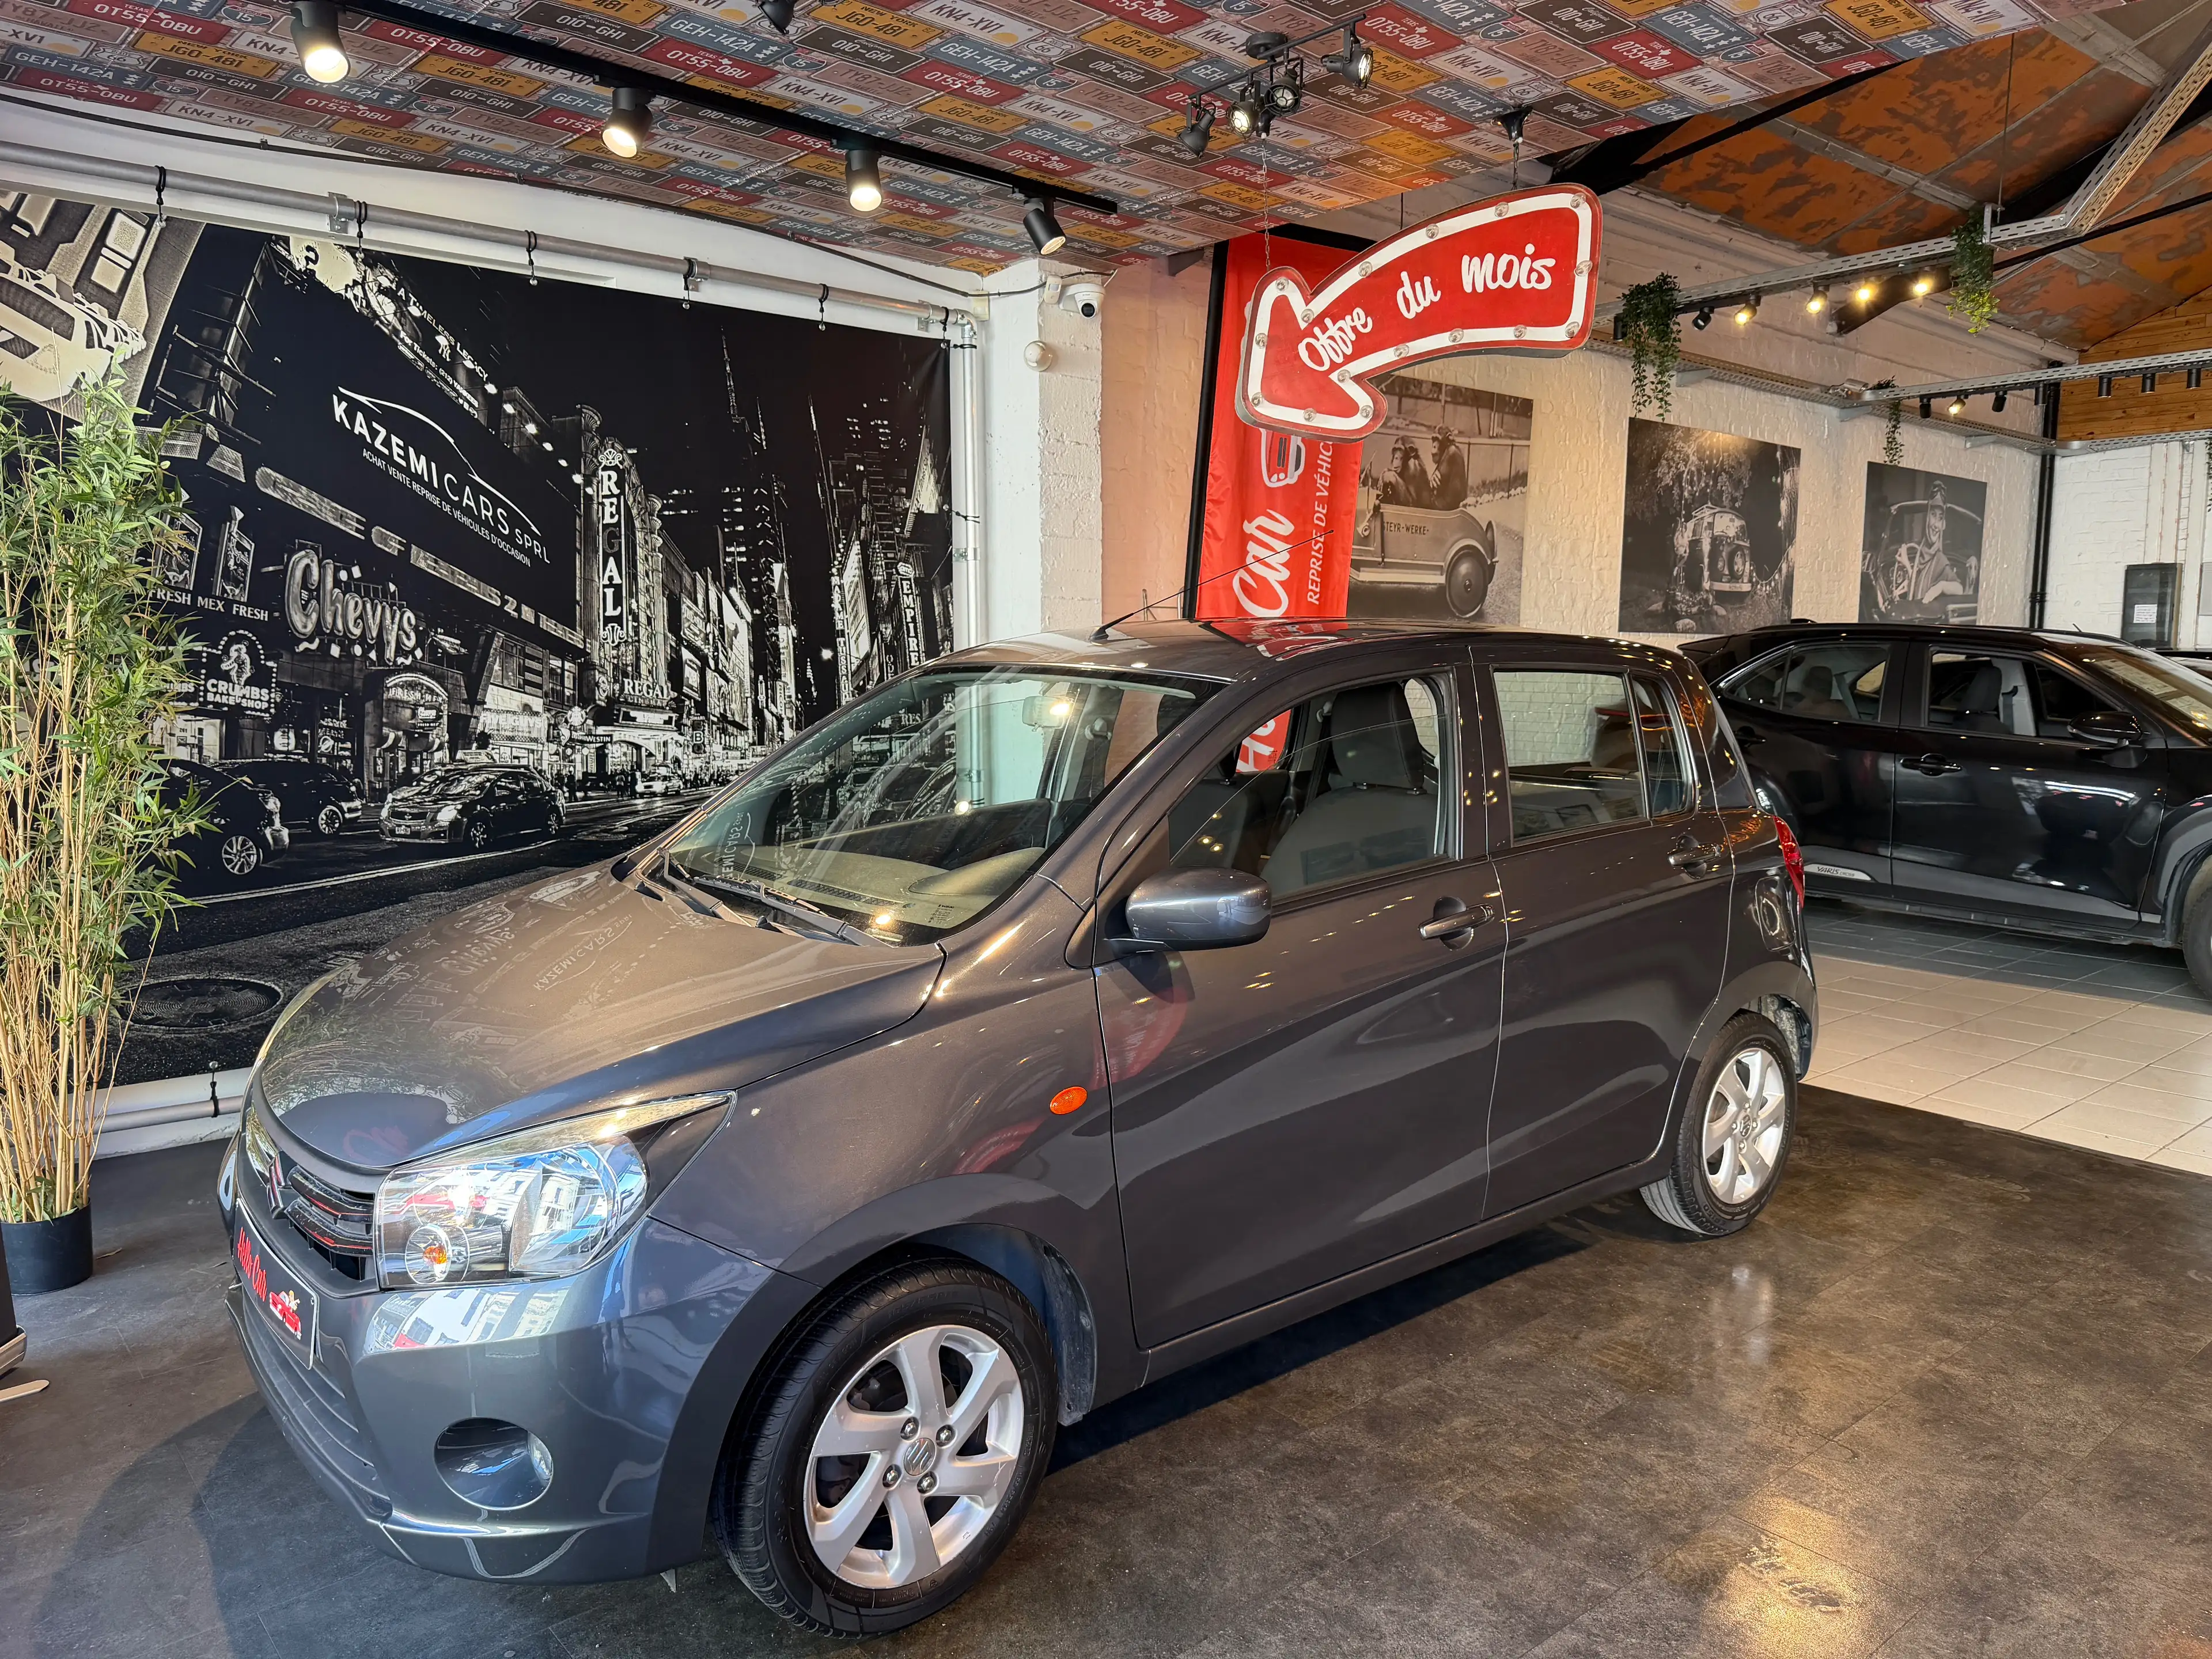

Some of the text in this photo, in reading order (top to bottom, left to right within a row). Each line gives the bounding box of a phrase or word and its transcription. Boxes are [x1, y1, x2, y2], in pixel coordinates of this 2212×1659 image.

[124, 3, 150, 13] TEXAS
[1230, 1, 1247, 10] 15
[235, 12, 252, 22] 15
[861, 6, 919, 27] NEW YORK
[1402, 17, 1419, 27] TEXAS
[1661, 10, 1725, 43] GEH-142A
[670, 18, 756, 52] GEH-142A
[1131, 29, 1180, 50] NEW YORK
[1487, 26, 1510, 37] 15
[696, 50, 717, 59] TEXAS
[940, 43, 1017, 73] GEH-142A
[1035, 45, 1051, 53] 66
[1728, 50, 1751, 59] 15
[15, 52, 114, 79] GEH-142A
[793, 58, 811, 67] 15
[166, 85, 181, 93] 15
[1043, 78, 1056, 86] 15
[1515, 88, 1531, 96] 66
[1617, 75, 1653, 93] NEW YORK
[424, 104, 437, 112] 15
[1427, 86, 1482, 112] GEH-142A
[1025, 126, 1085, 151] GEH-142A
[1298, 243, 1556, 372] Offre du mois
[333, 393, 551, 564] KAZEMI CARS SPRL
[362, 448, 531, 567] ACHAT VENTE REPRISE DE VÉHICULES D'OCCASION
[1313, 501, 1327, 528] DE
[601, 470, 622, 617] REGAL
[1233, 509, 1296, 618] Car
[1307, 532, 1325, 605] REPRISE
[149, 588, 269, 622] FRESH MEX FRESH
[286, 549, 417, 666] Chevys
[831, 577, 845, 630] MADAME
[902, 581, 920, 666] EMPIRE
[206, 678, 270, 702] CRUMBS
[623, 678, 671, 699] REGAL
[241, 698, 269, 710] SHOP
[586, 735, 611, 743] WESTIN
[1817, 866, 1839, 874] YARIS
[237, 1226, 268, 1302] Hello Car
